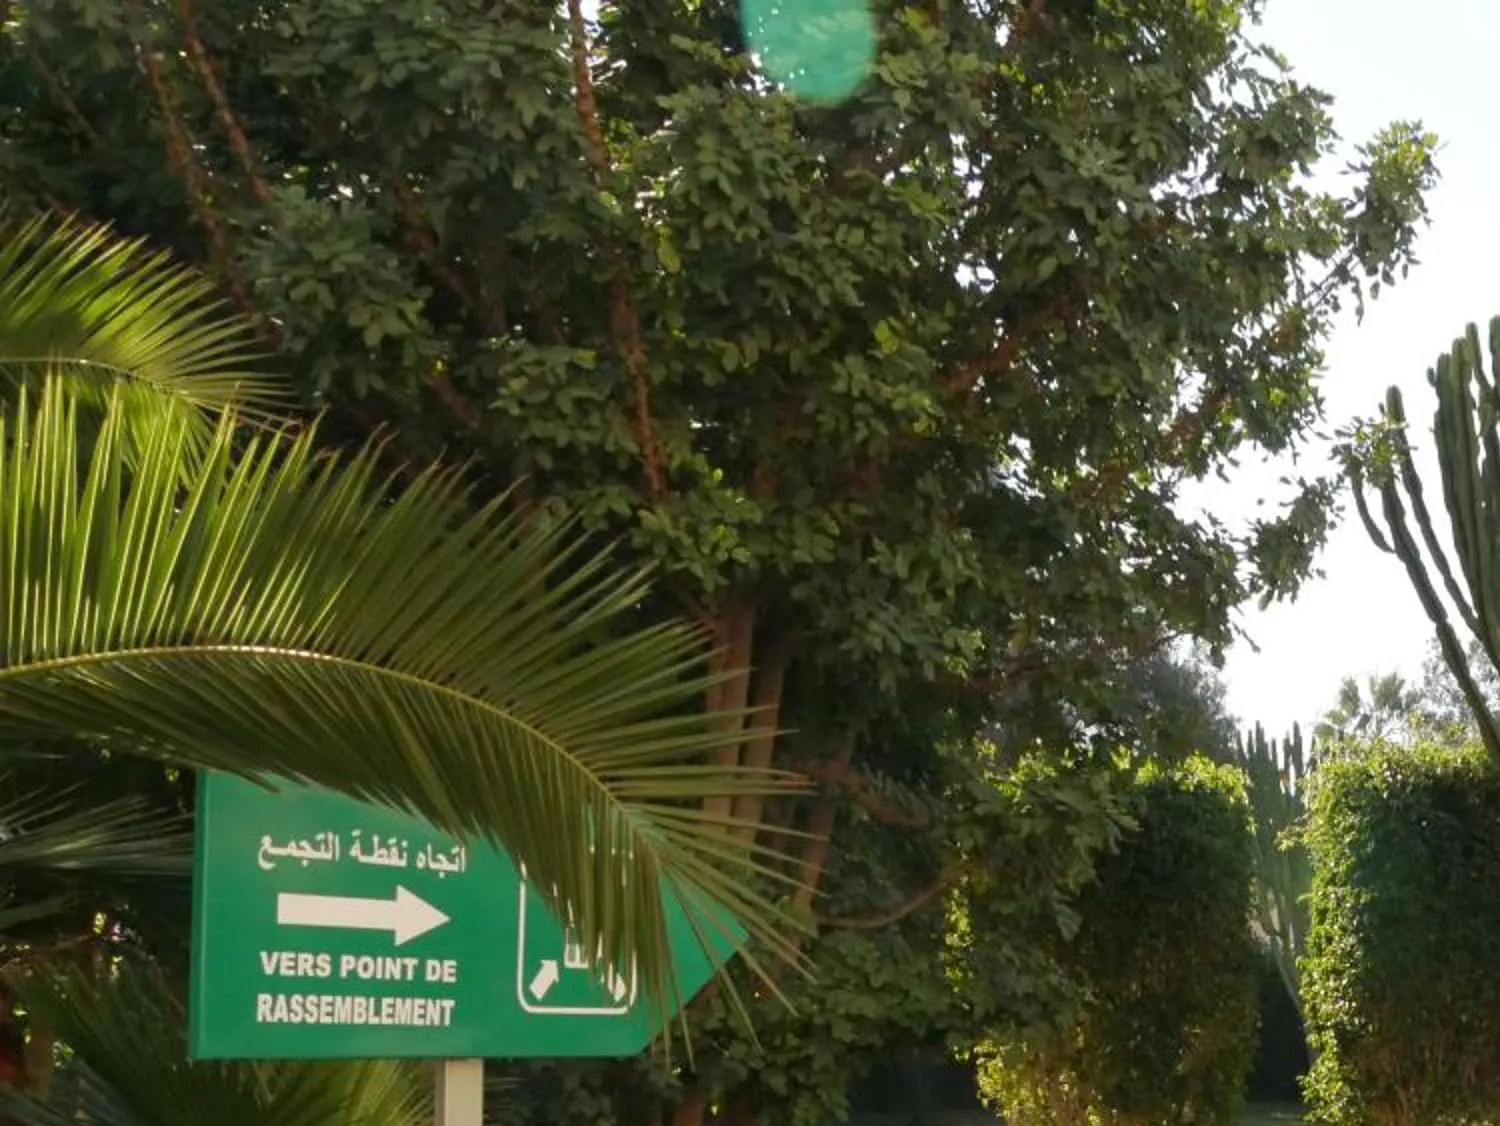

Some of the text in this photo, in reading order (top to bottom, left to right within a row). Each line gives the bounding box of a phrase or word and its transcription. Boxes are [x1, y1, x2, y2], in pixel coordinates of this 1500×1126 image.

[257, 829, 466, 879] اتجاه نقطة التجمع
[260, 951, 457, 983] VERS POINT DE
[256, 993, 455, 1027] RASSEMBLEMENT
